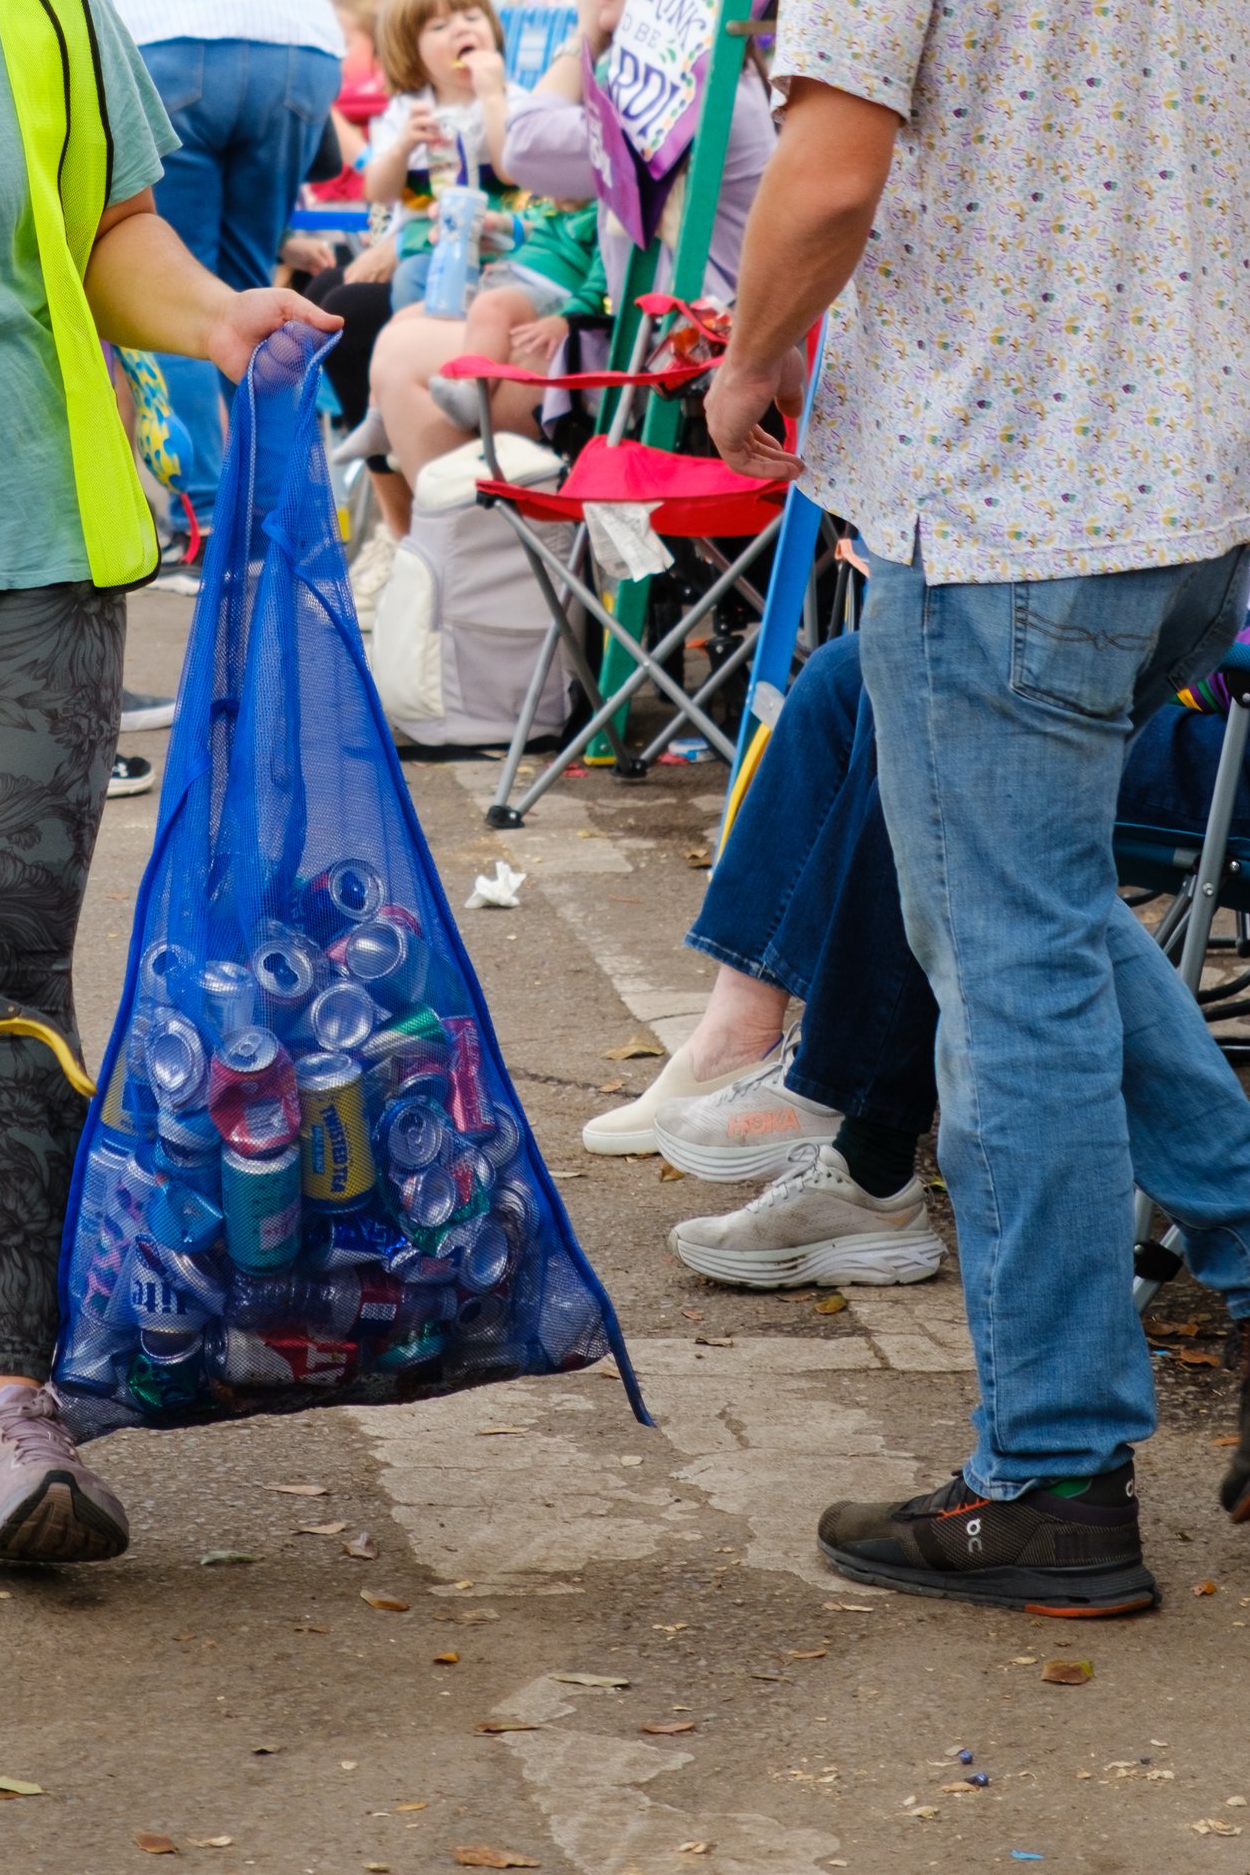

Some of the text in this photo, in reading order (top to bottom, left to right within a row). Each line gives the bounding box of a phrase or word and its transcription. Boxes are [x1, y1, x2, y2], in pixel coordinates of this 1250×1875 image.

[319, 1103, 348, 1192] TWISTED TEA
[728, 1107, 801, 1138] HOKA
